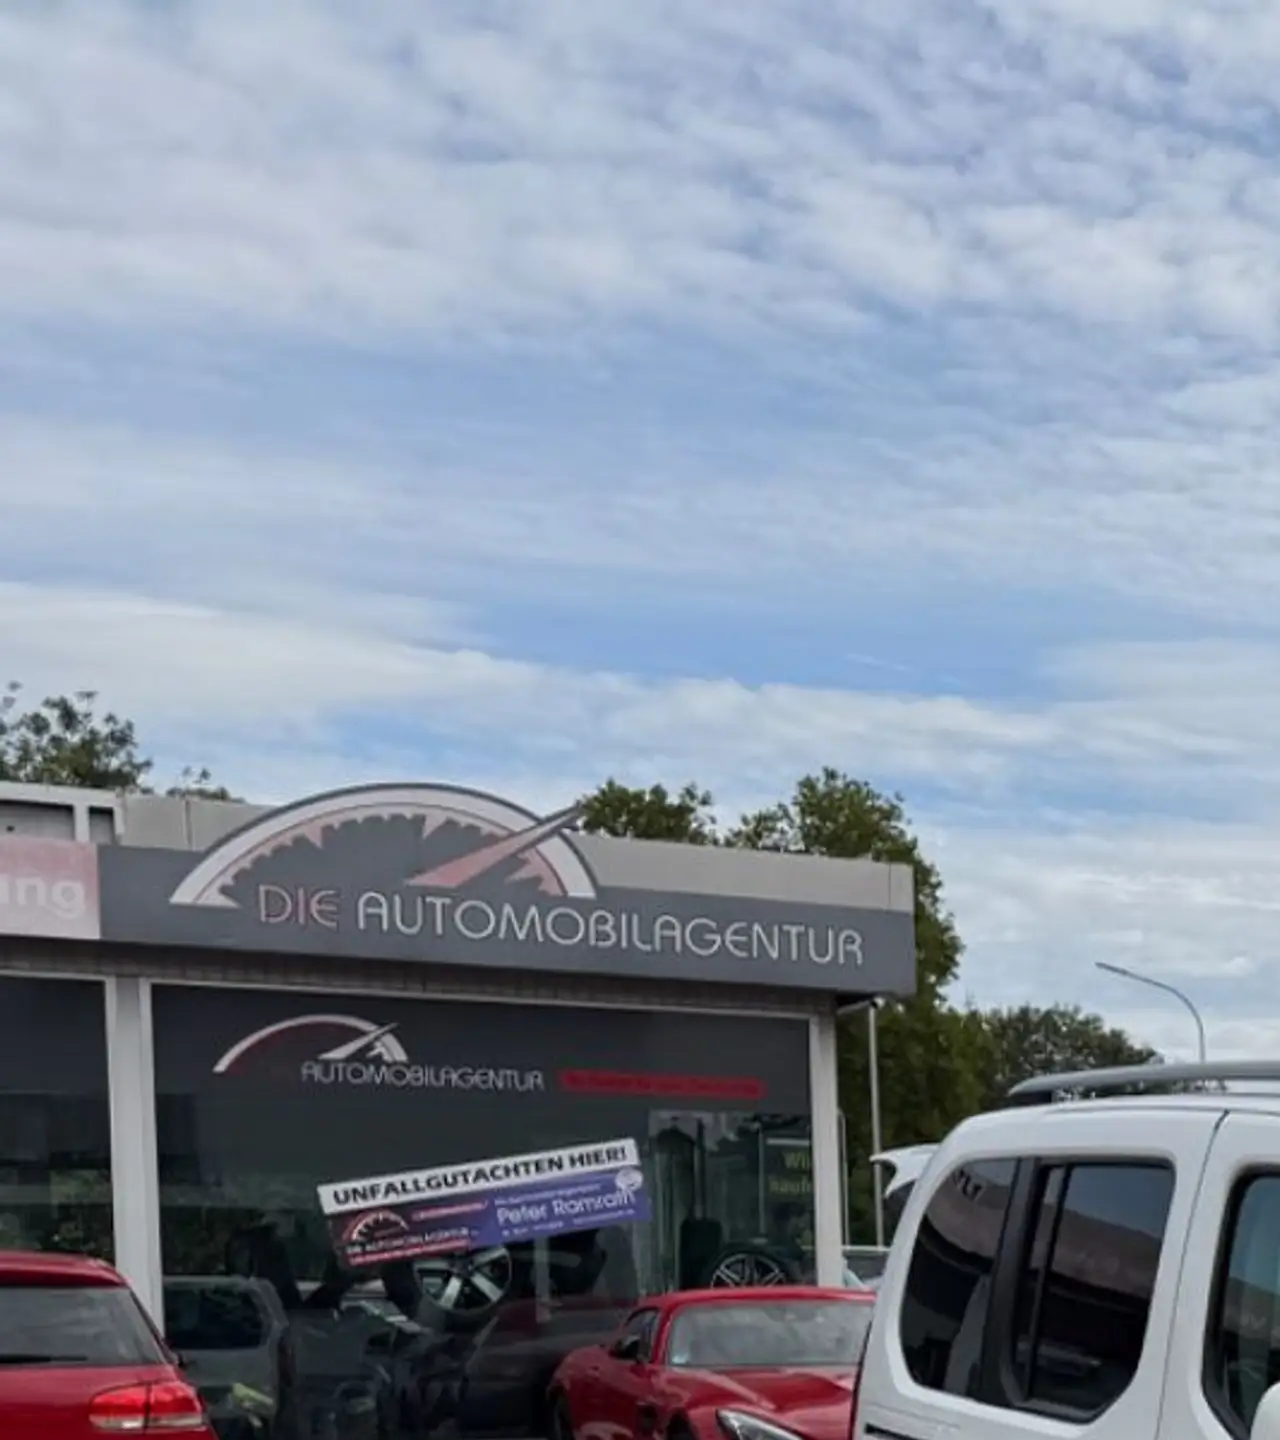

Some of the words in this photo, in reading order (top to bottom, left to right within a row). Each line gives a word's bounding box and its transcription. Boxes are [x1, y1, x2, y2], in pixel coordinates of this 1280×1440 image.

[258, 883, 338, 929] DIE
[357, 890, 864, 966] AUTOMOBILAGENTUR
[301, 1060, 545, 1092] AUTOMOBILAGENTUR
[333, 1154, 563, 1206] UNFALLGUTACHTEN
[569, 1145, 628, 1170] HIER!
[497, 1204, 547, 1225] Peter
